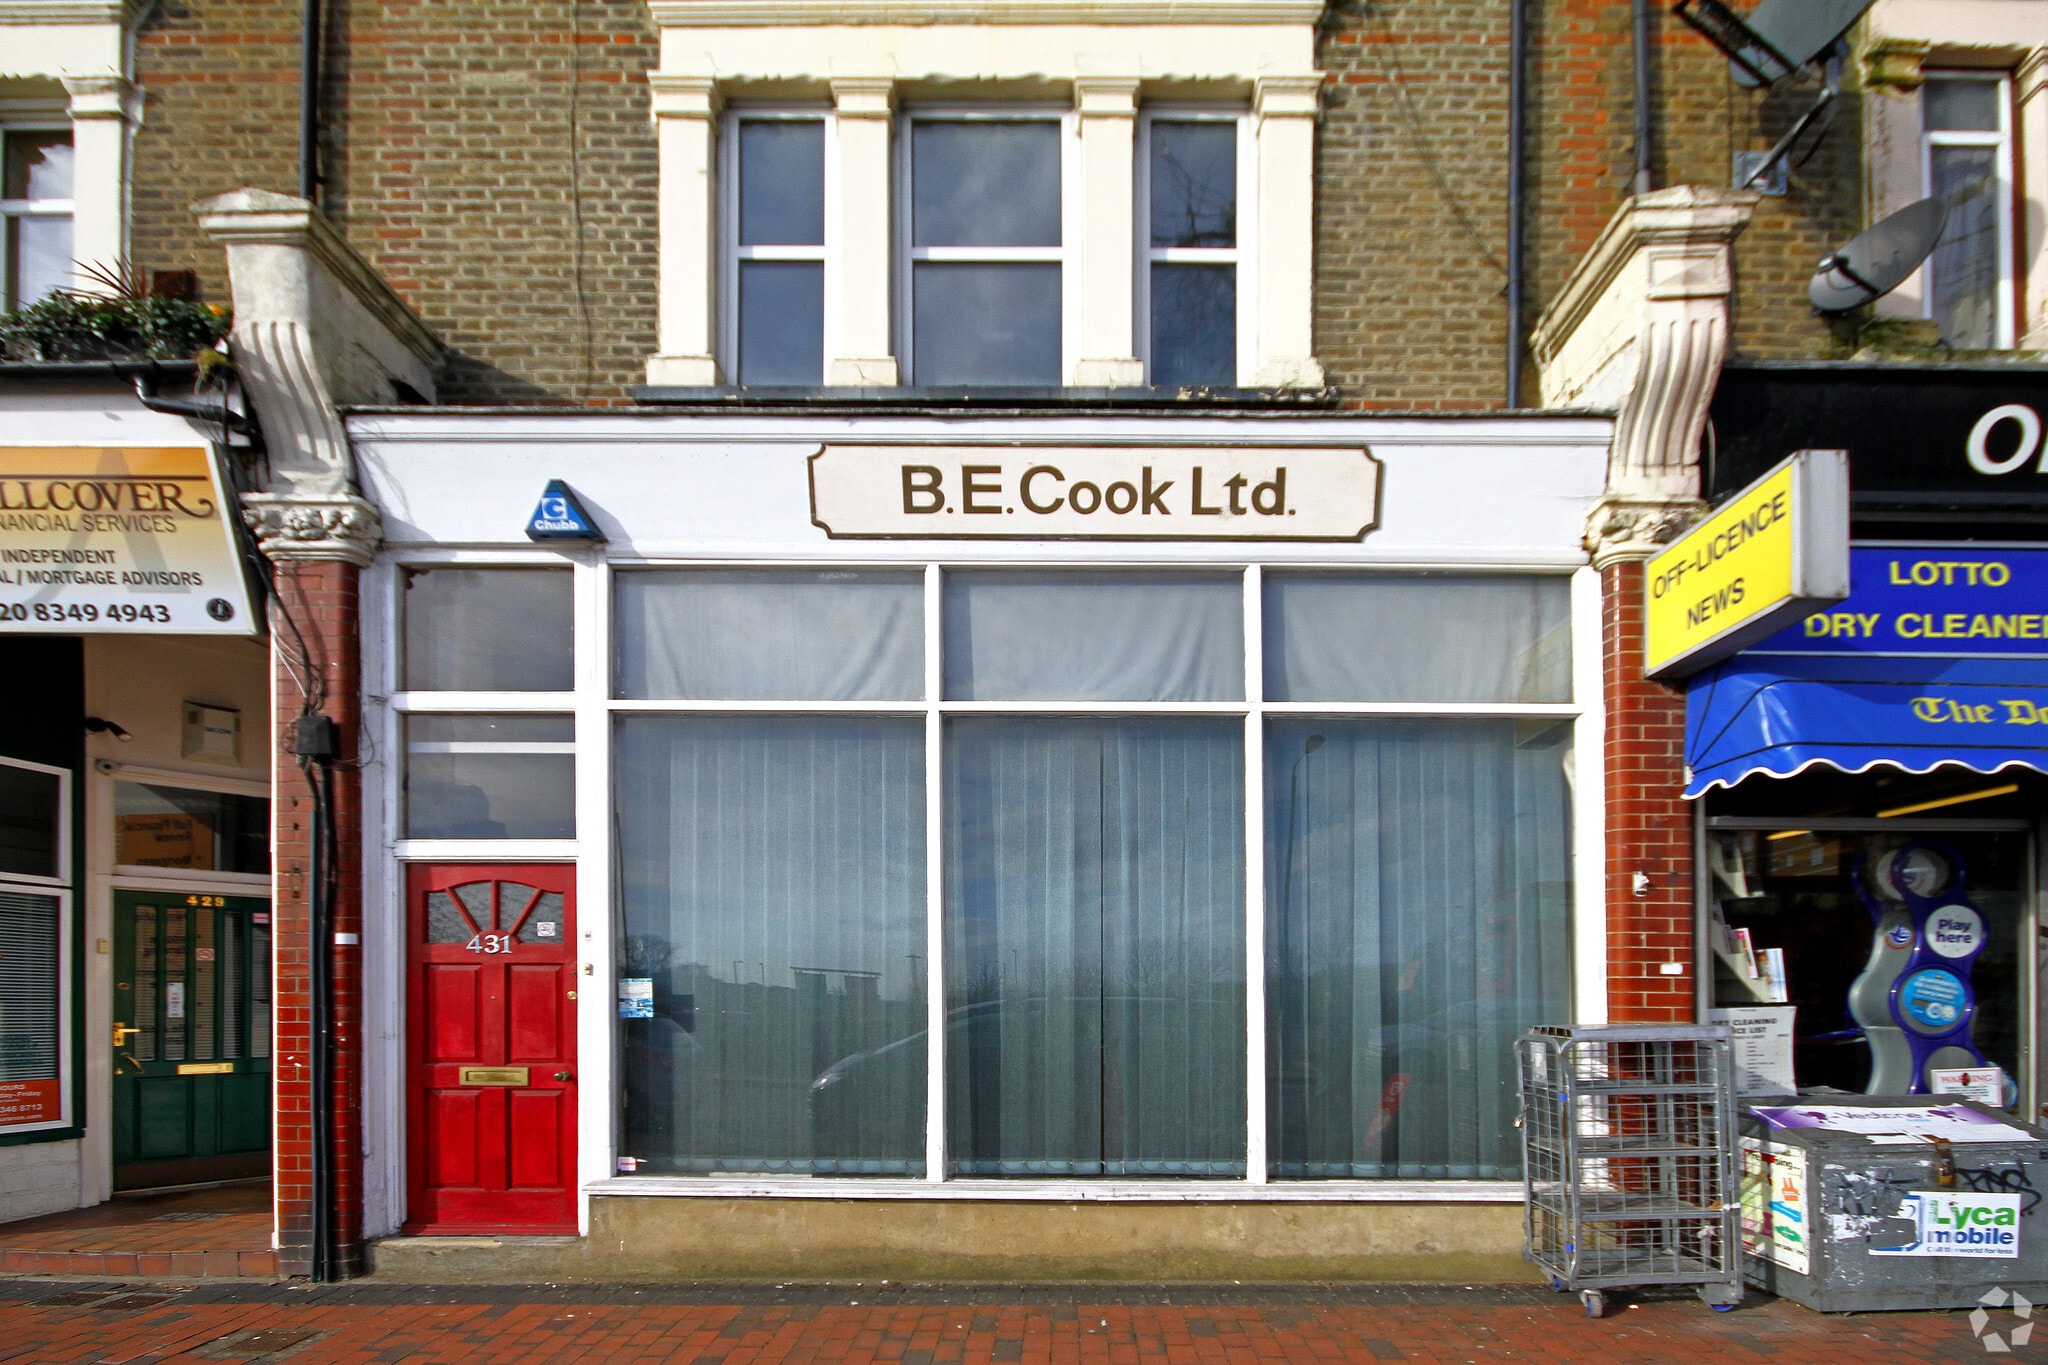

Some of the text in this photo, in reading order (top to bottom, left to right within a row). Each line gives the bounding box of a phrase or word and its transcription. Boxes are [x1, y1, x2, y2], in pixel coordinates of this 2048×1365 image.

[1966, 404, 2048, 474] O
[1191, 465, 1297, 516] Ltd.
[83, 514, 177, 533] SERVICES
[534, 520, 580, 531] Chubb
[1653, 490, 1786, 599] OFF-LICENCE
[3, 550, 116, 564] INDEPENDENT
[0, 570, 14, 584] L
[26, 570, 116, 585] MORTGAGE
[122, 571, 203, 586] ADVISORS
[1889, 560, 2011, 587] LOTTO
[0, 603, 171, 623] 20 8349 4943
[1687, 576, 1745, 630] NEWS
[1804, 612, 2048, 639] DRY CLEANE
[1909, 696, 1997, 724] The
[186, 895, 224, 907] 429
[1938, 919, 1972, 933] Play
[466, 934, 513, 954] 431
[1936, 931, 1972, 943] here
[1733, 1018, 1777, 1026] CLEANING
[1928, 1199, 2016, 1230] Lyca
[1927, 1227, 2014, 1245] mobile
